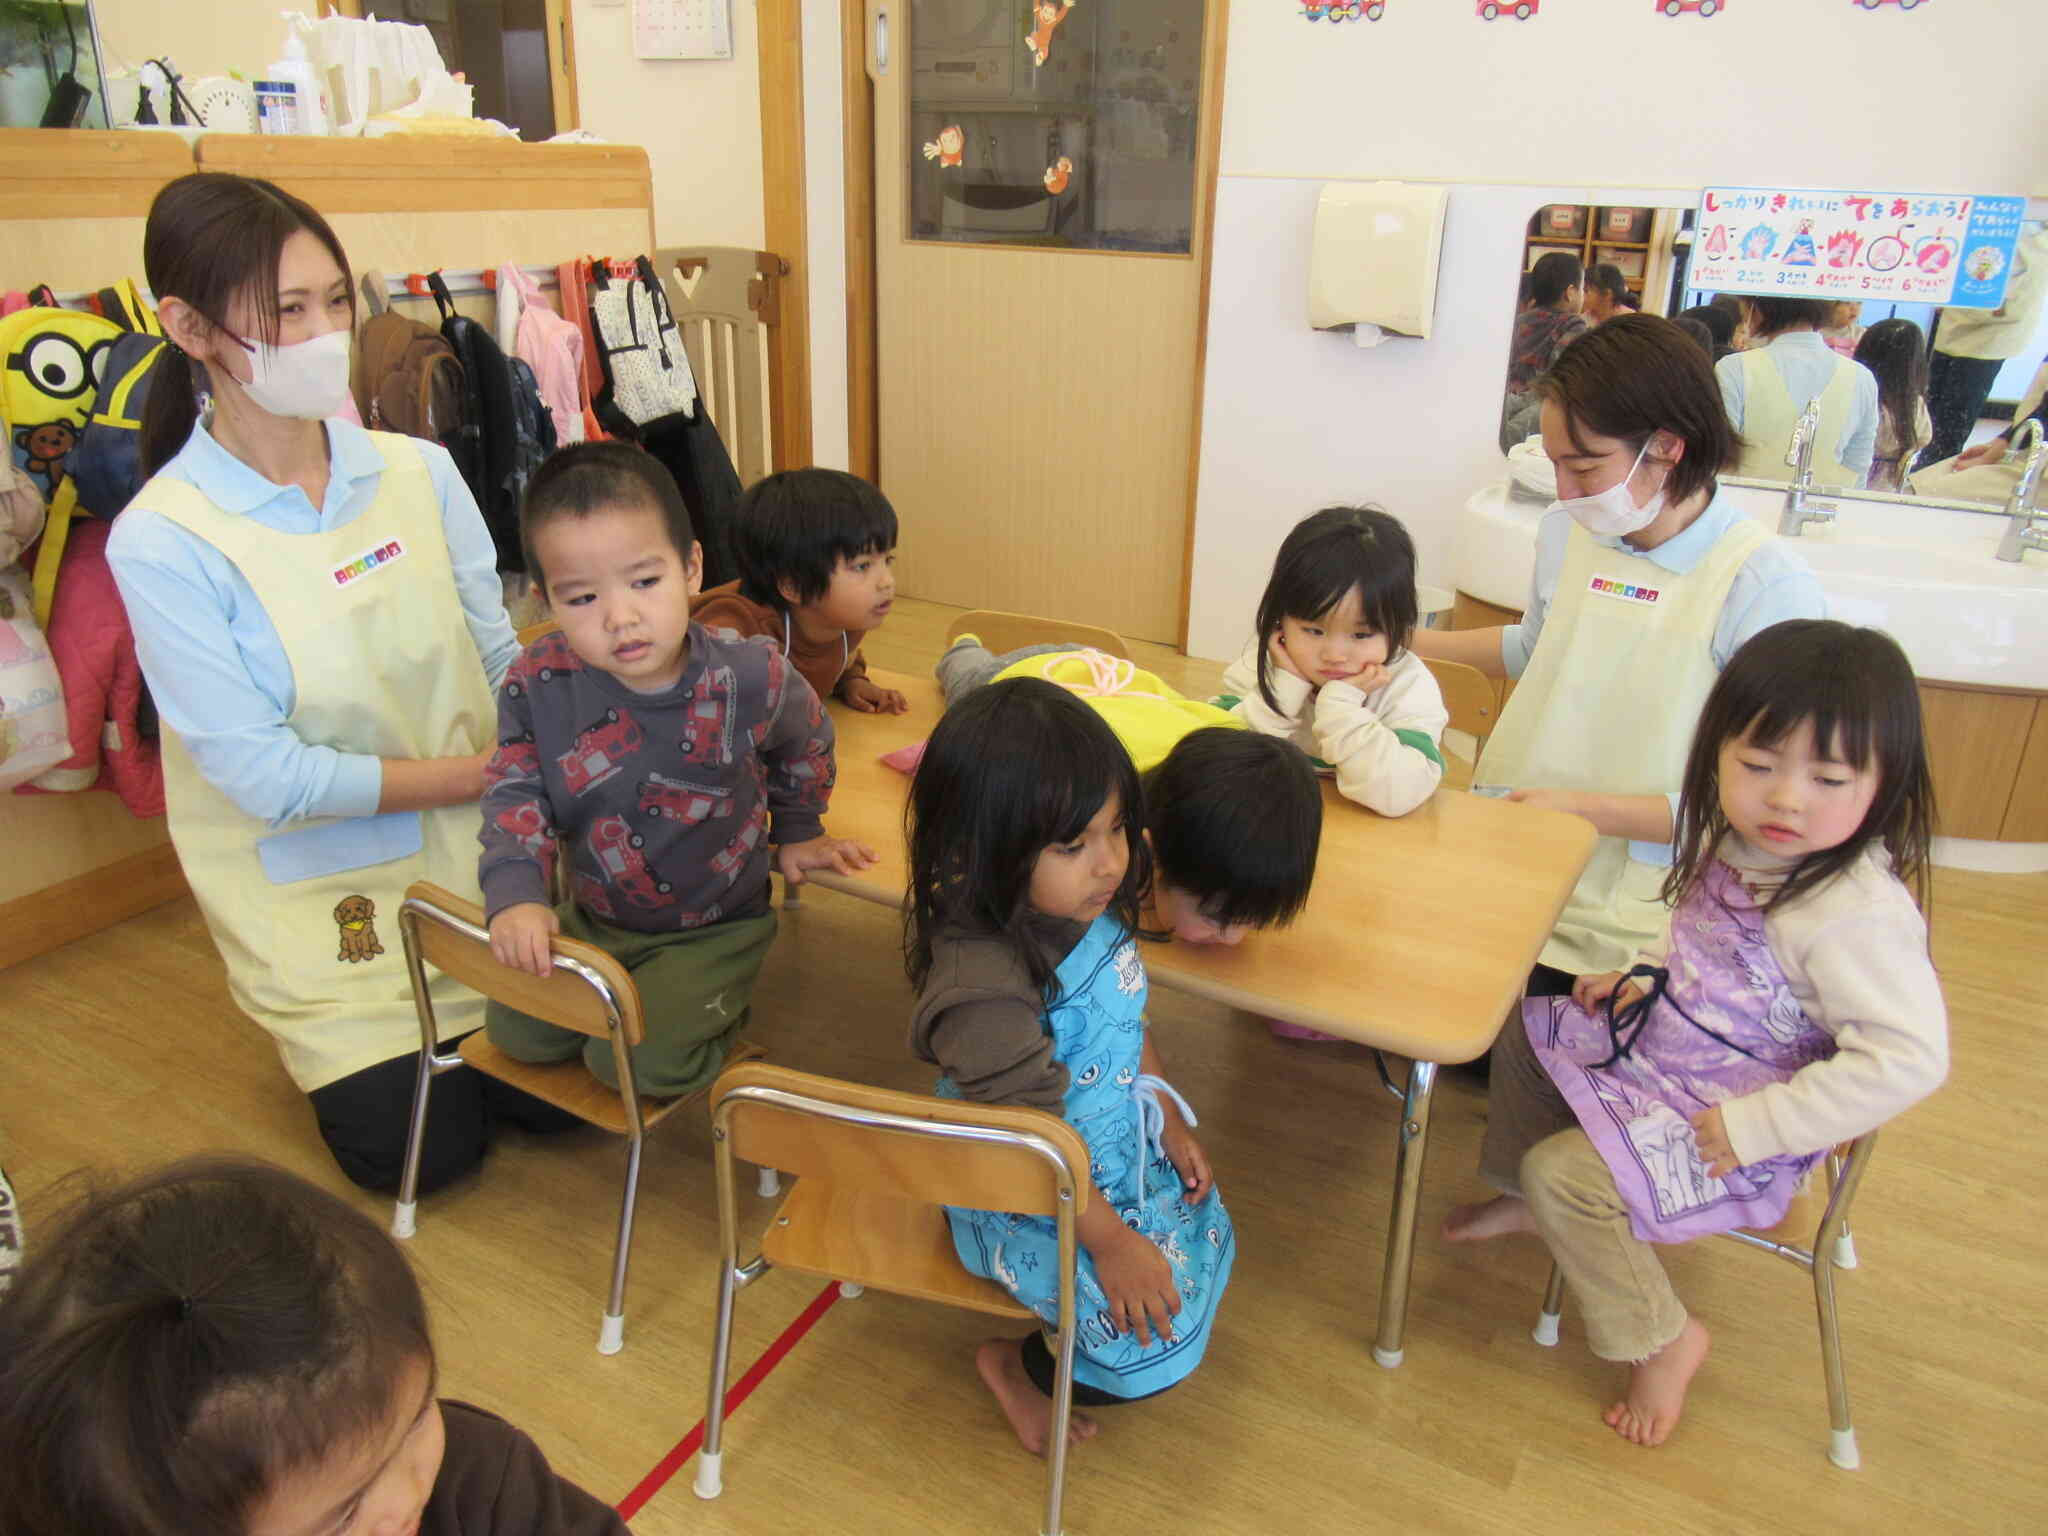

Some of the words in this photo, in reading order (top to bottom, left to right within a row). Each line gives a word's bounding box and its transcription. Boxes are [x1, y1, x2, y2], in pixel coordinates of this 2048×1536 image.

[1737, 270, 1746, 282] 2
[1776, 271, 1786, 284] 3
[1815, 273, 1825, 286] 4
[1860, 276, 1872, 289] 5
[1902, 279, 1912, 291] 6
